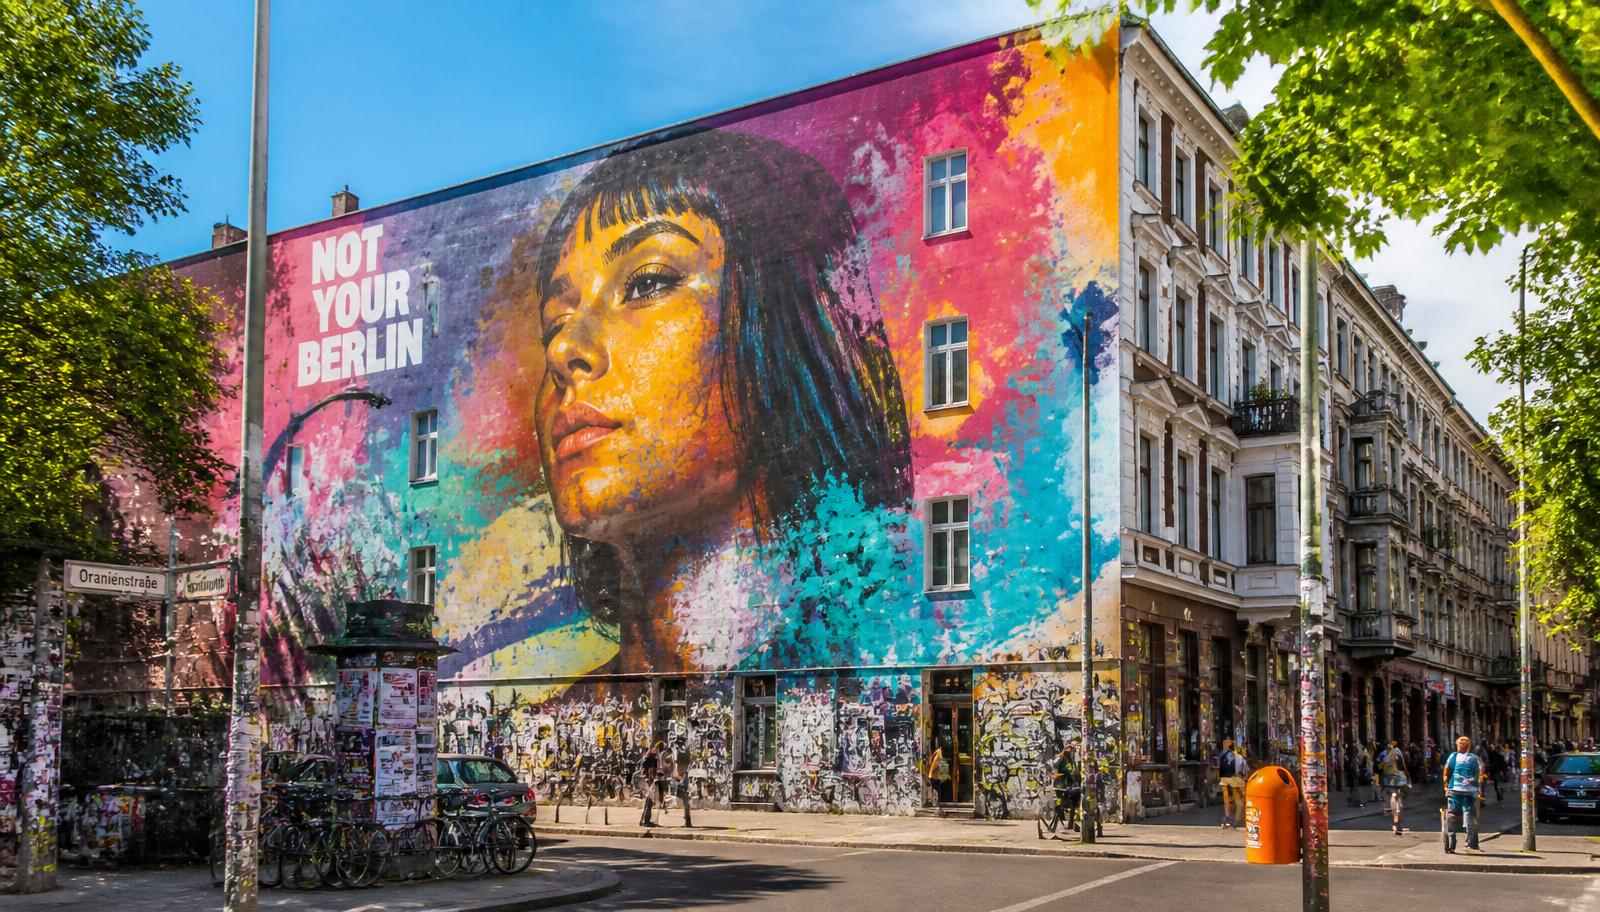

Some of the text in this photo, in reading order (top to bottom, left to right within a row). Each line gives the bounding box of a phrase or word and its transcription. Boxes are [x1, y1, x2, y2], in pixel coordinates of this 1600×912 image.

[312, 224, 384, 285] NOT
[312, 269, 411, 333] YOUR
[297, 318, 424, 388] BERLIN
